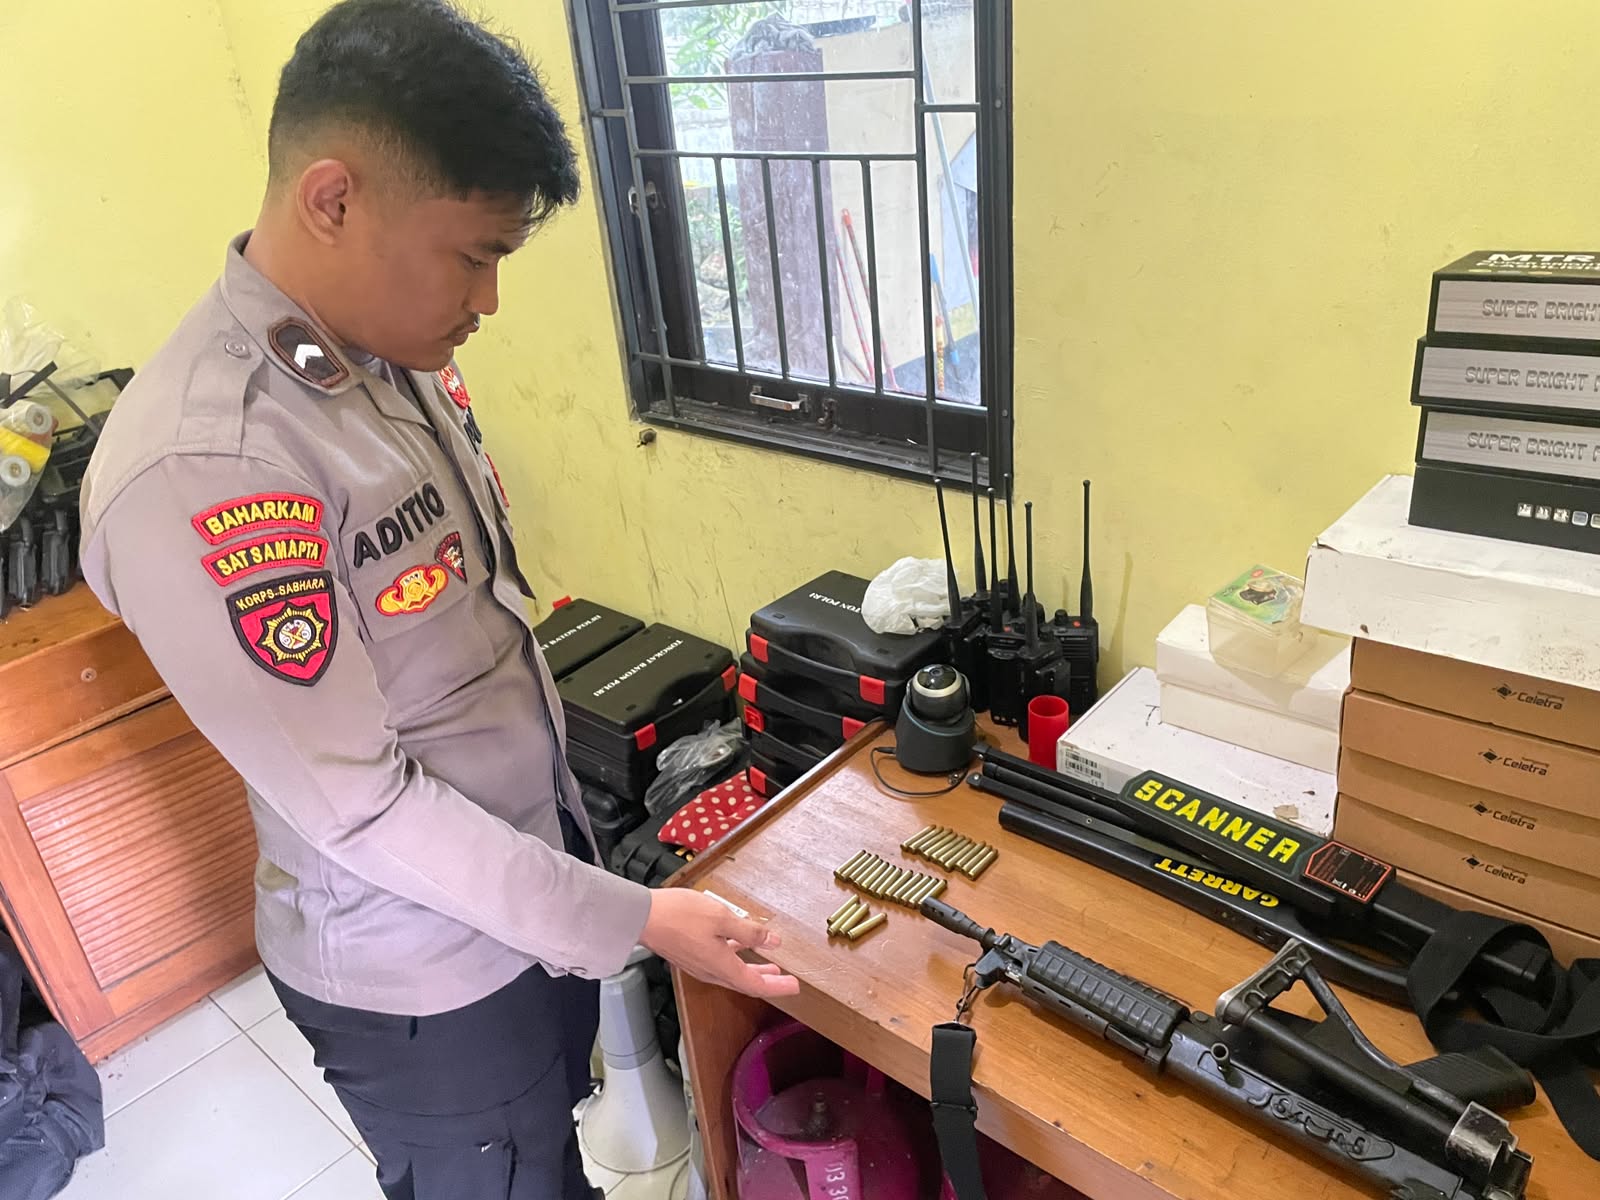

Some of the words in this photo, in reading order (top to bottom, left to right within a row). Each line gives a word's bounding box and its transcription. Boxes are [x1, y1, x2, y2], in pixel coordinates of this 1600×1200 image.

[1488, 253, 1595, 262] MTR
[1482, 299, 1538, 318] SUPER
[1544, 301, 1600, 321] BRIGH
[1465, 366, 1520, 386] SUPER
[1525, 370, 1589, 391] BRIGHT
[1467, 432, 1520, 453] SUPER
[1526, 437, 1588, 460] BRIGHT
[205, 500, 315, 535] BAHARKAM
[353, 482, 445, 569] ADITIO
[216, 550, 249, 576] SAT
[250, 539, 319, 563] SAMAPTA
[235, 578, 325, 611] KORPS-SABHARA
[549, 628, 577, 646] BATON
[646, 639, 684, 665] TONGKAT
[619, 662, 647, 681] BATON
[592, 679, 621, 697] POLRI
[1134, 780, 1300, 863] SCANNER
[1154, 858, 1279, 907] GARRETT
